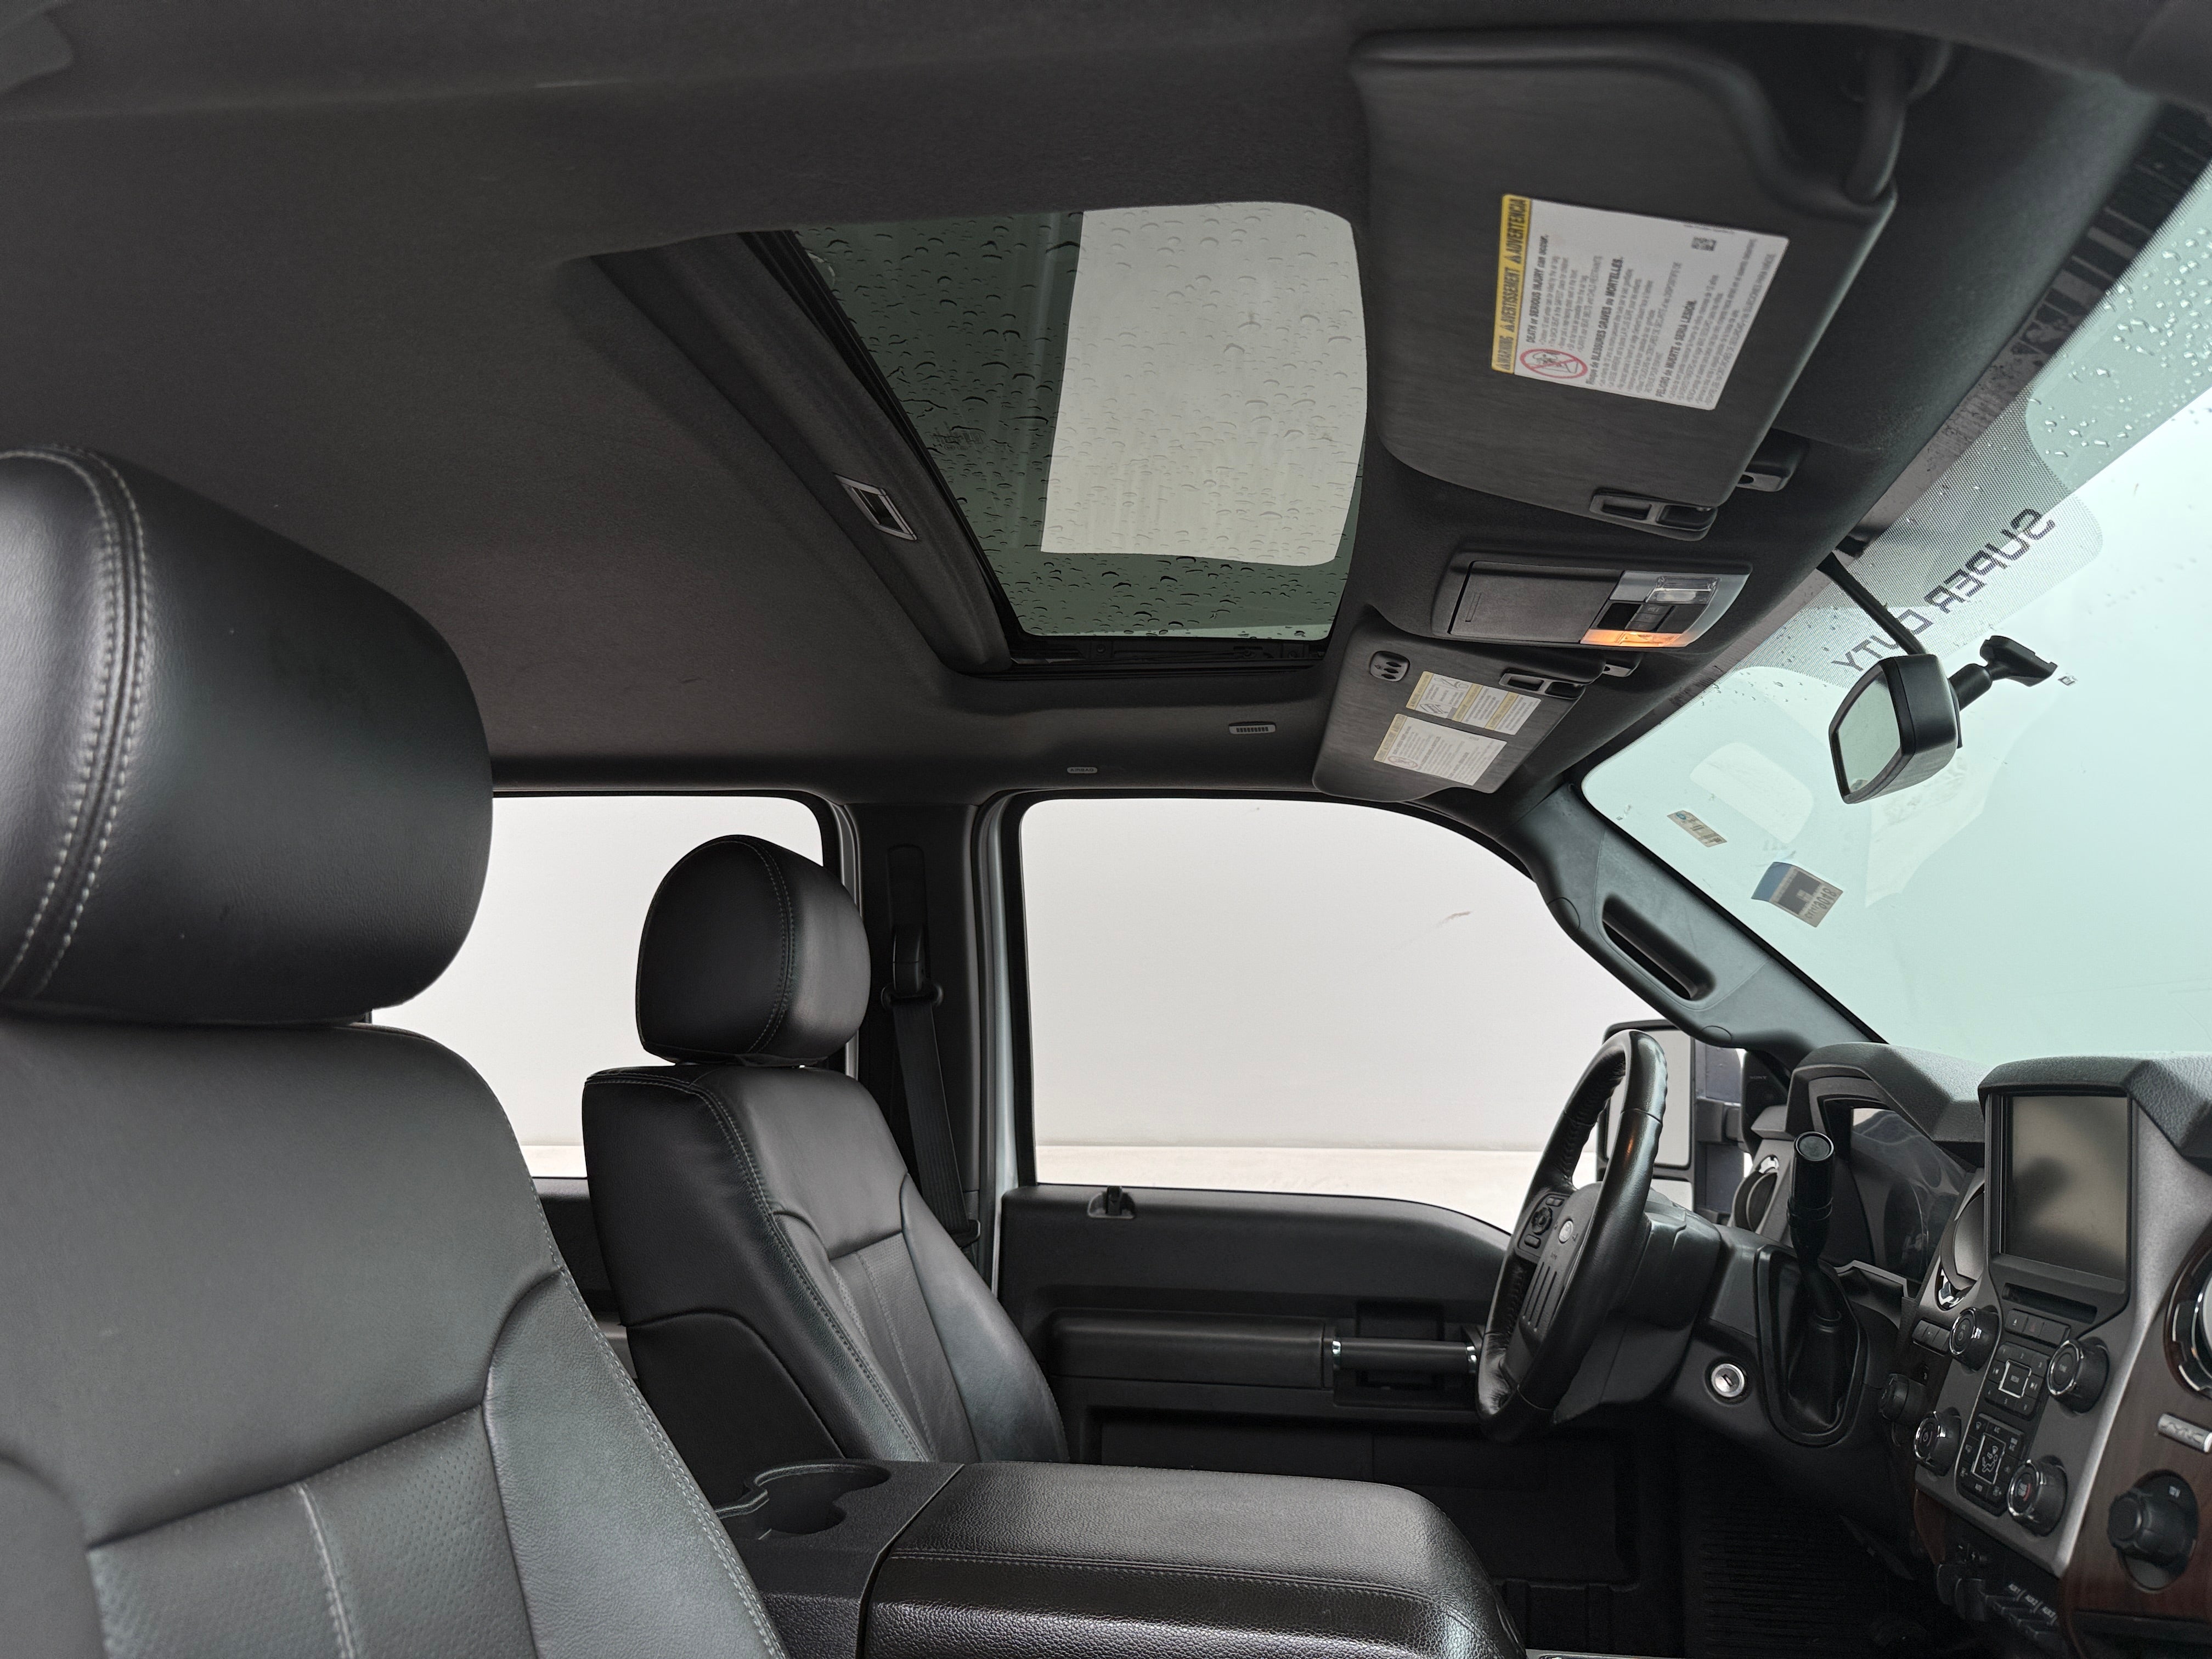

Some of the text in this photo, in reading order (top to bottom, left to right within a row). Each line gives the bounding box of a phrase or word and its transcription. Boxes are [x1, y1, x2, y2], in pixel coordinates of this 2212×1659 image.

[1504, 198, 1528, 255] ADVERTENCIA
[1531, 267, 1545, 291] INJURY
[1603, 255, 1624, 297] MORTELLES.
[1499, 266, 1521, 325] AVERTISSEMENT
[1528, 290, 1542, 318] SERIOUS
[1596, 305, 1612, 330] GRAVES
[1525, 324, 1537, 343] DEATH
[1673, 323, 1689, 341] SERIA
[1497, 335, 1514, 364] WARNING
[1590, 329, 1607, 362] BLESSURES
[1663, 345, 1681, 369] MUERTE
[1589, 360, 1599, 369] de
[1661, 368, 1673, 376] de
[1654, 375, 1671, 398] PELIGRO
